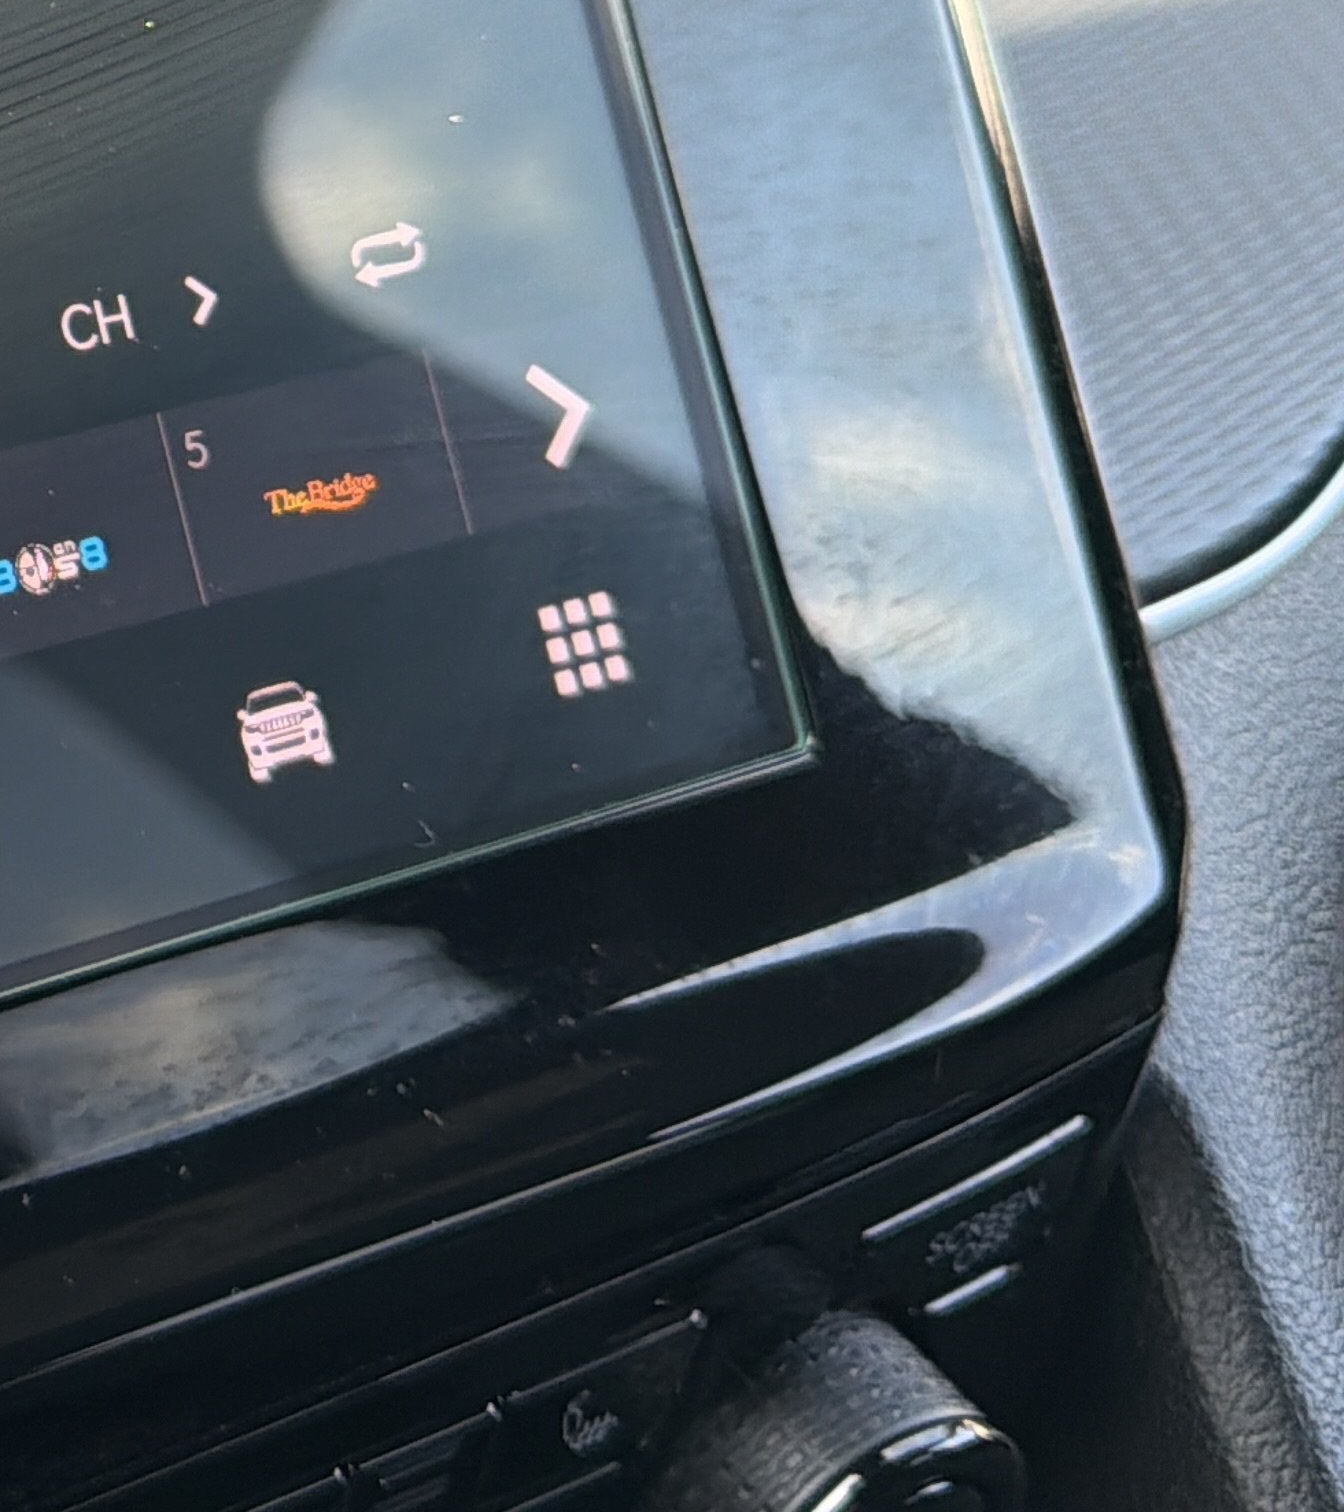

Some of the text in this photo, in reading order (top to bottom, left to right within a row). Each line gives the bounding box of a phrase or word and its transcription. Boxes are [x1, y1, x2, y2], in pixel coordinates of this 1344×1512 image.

[59, 294, 136, 352] CH
[184, 429, 209, 470] 5
[306, 472, 378, 502] Bridge
